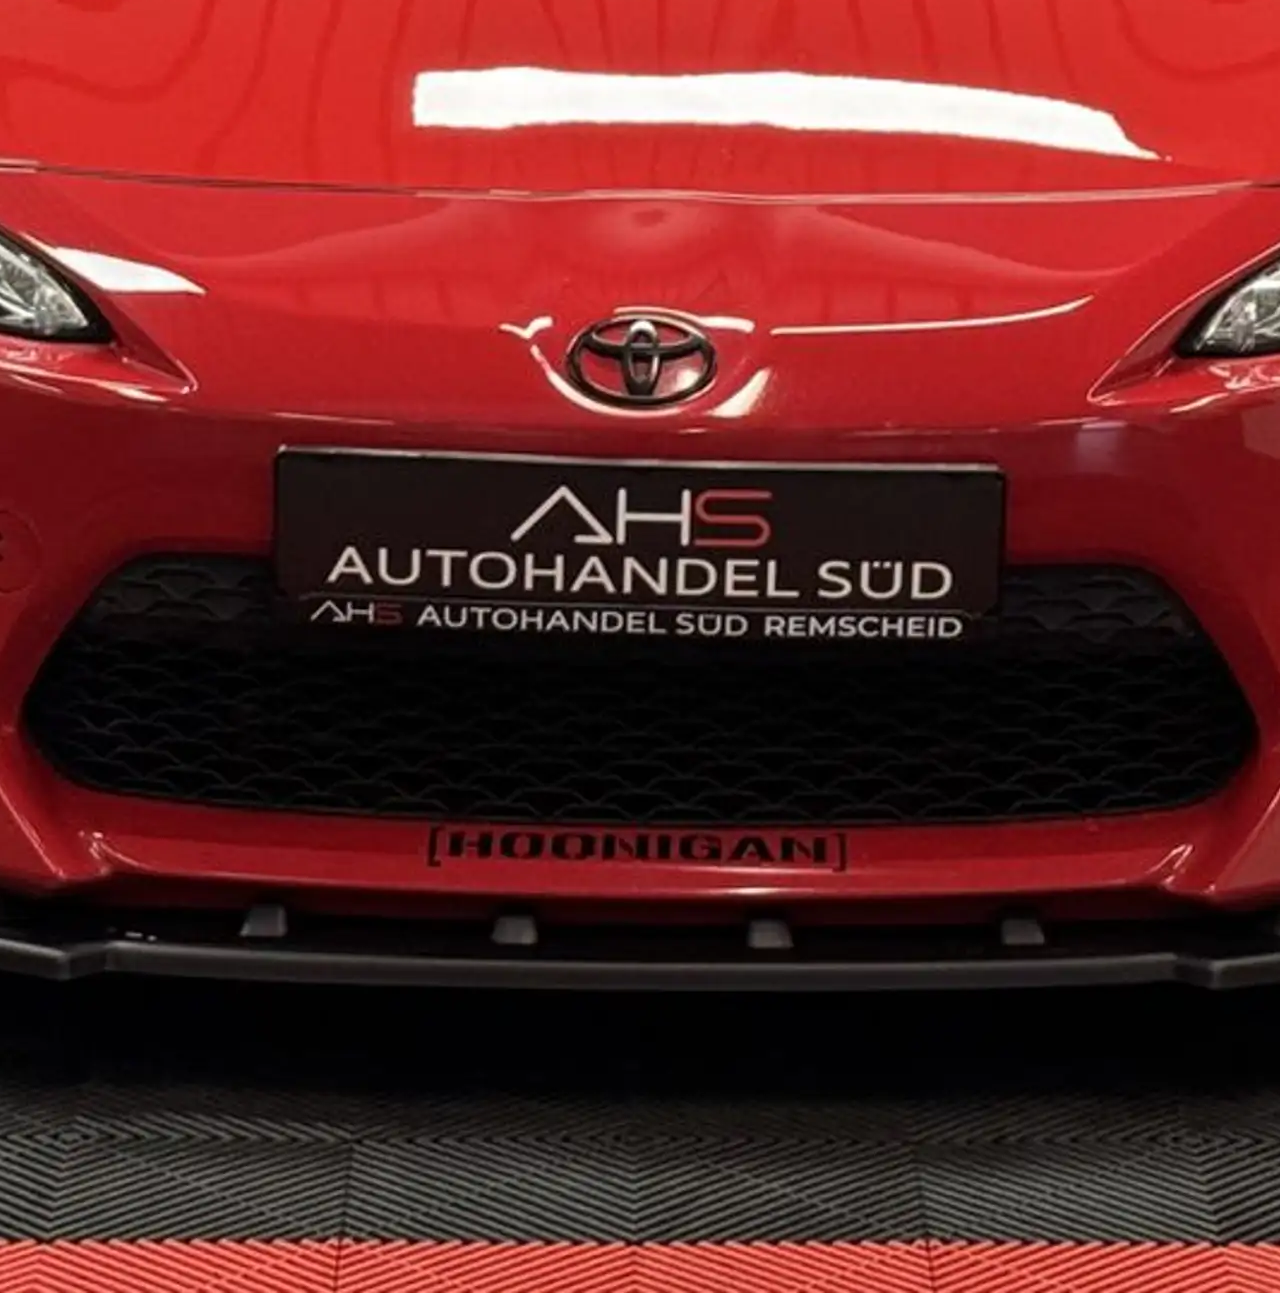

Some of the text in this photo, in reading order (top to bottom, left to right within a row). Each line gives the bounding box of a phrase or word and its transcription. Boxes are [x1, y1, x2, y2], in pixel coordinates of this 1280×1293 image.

[510, 484, 774, 549] AHS
[325, 545, 954, 600] AUTOHANDEL SÜD
[309, 599, 965, 640] AHS AUTOHANDEL SÜD REMSCHEID
